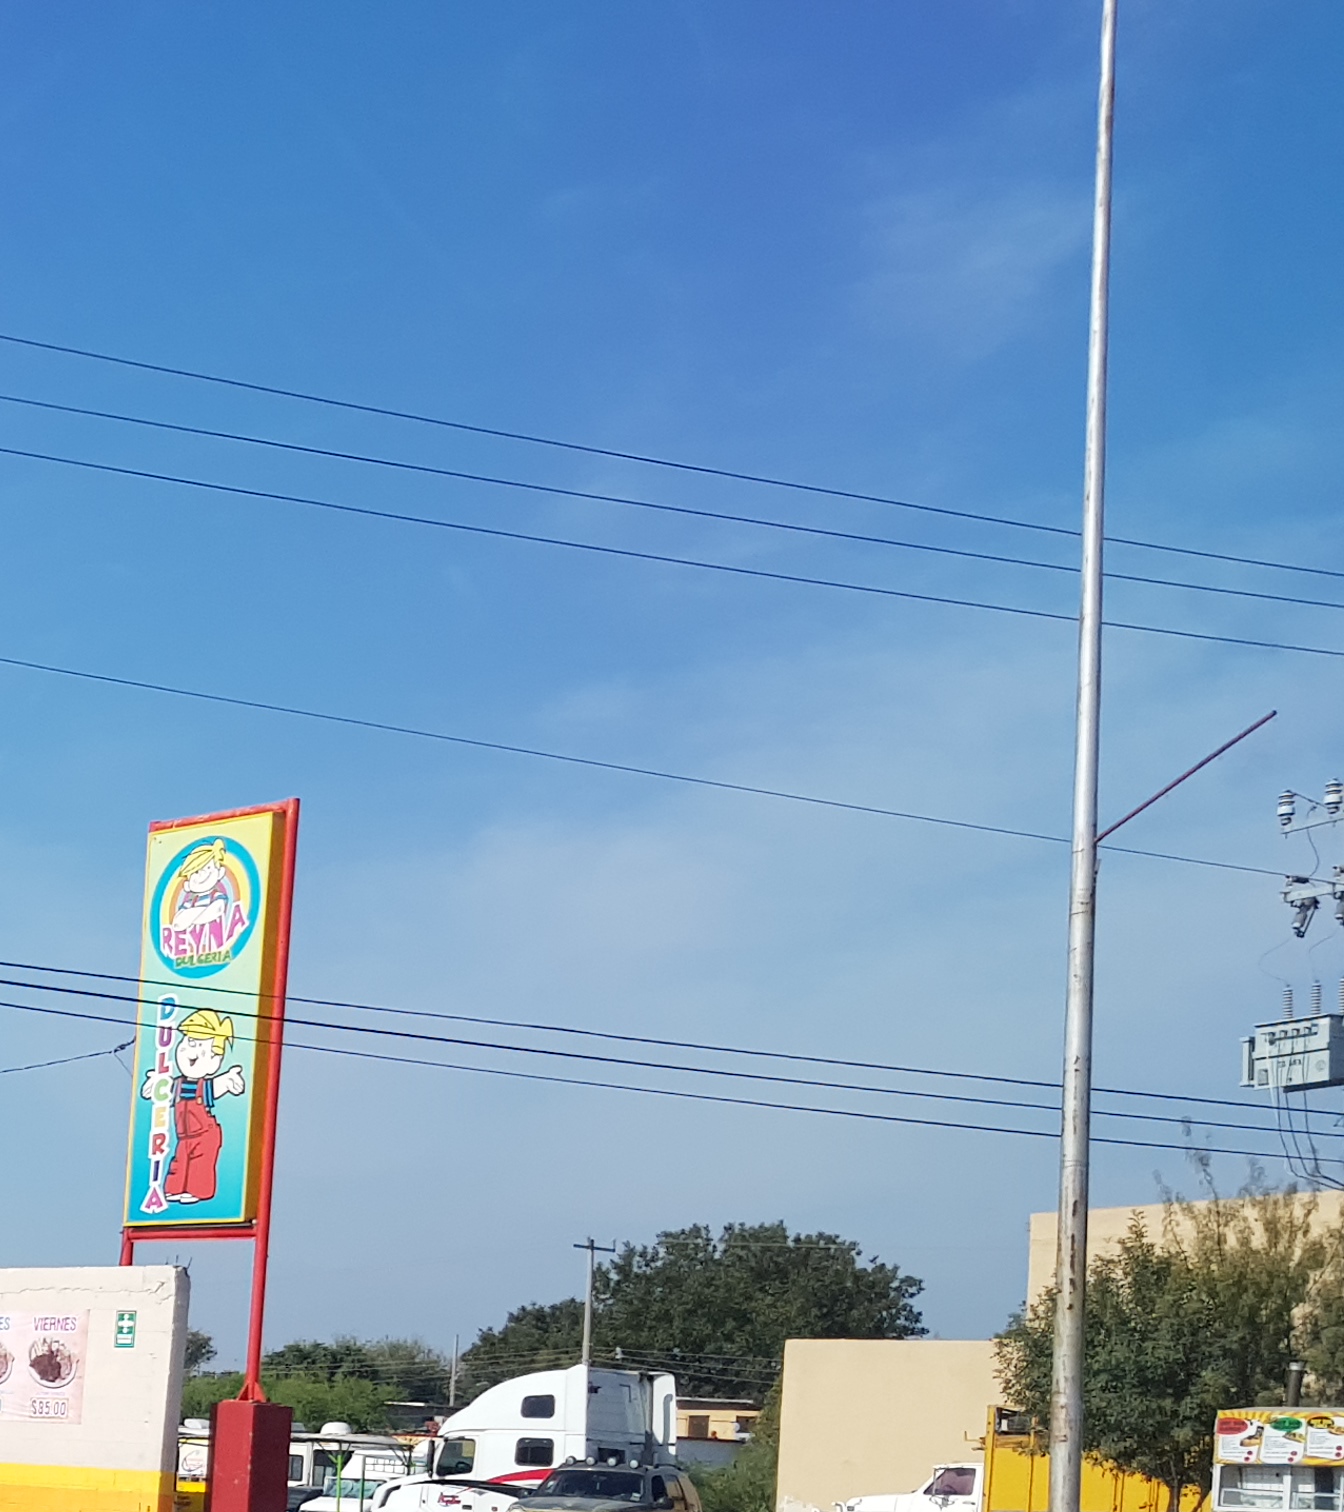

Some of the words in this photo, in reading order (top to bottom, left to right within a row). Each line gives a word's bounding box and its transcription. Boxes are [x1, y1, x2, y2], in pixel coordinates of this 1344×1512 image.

[163, 904, 246, 956] REYNA
[175, 950, 231, 967] DULCERIA
[144, 997, 176, 1210] DULCERIA
[34, 1317, 77, 1331] VIERNES
